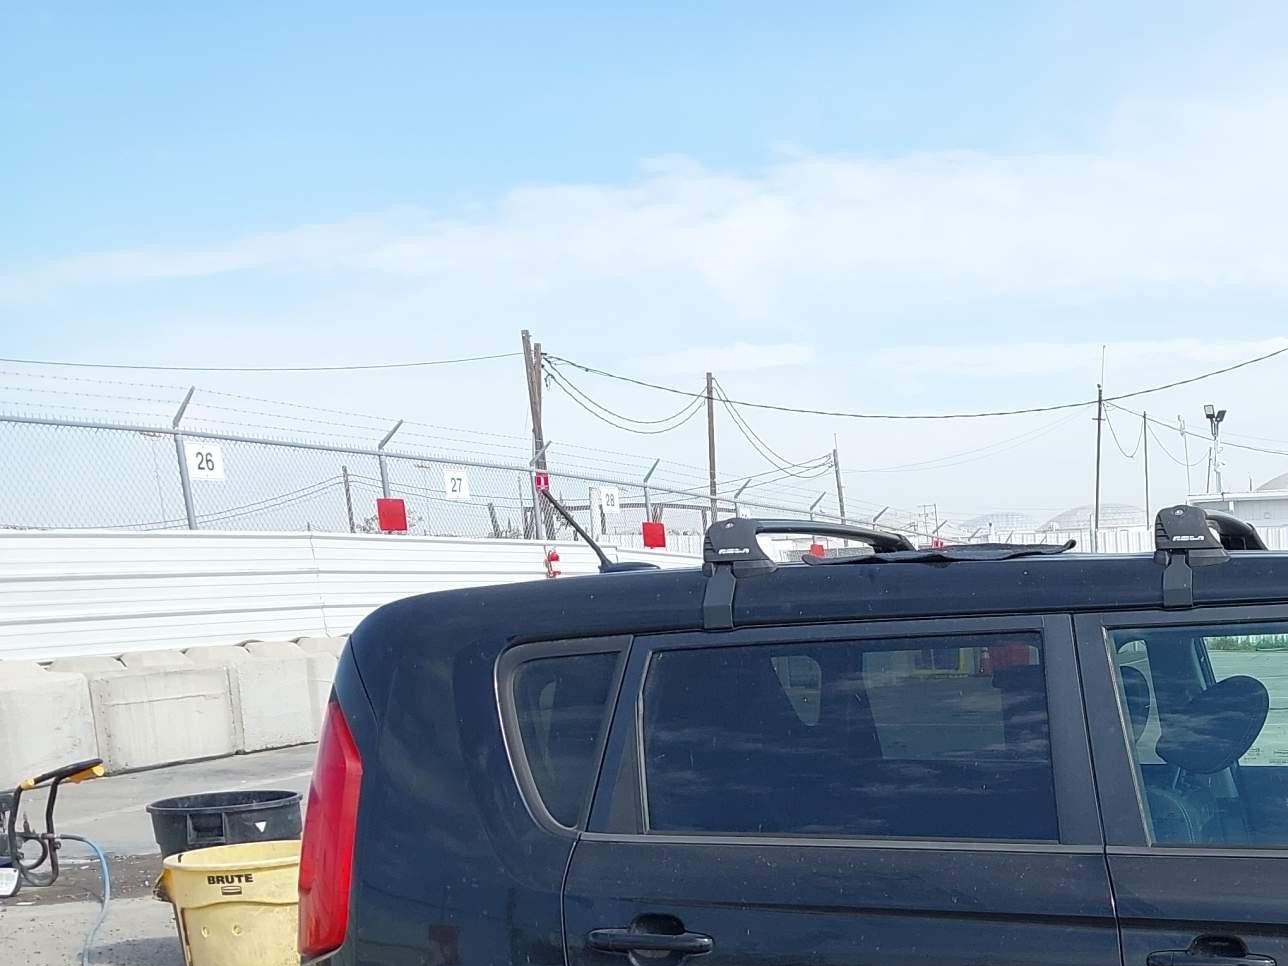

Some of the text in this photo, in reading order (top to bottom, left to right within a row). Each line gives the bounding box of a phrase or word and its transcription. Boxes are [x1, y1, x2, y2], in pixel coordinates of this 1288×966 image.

[195, 451, 215, 471] 26
[450, 477, 463, 493] 27
[605, 493, 616, 507] 28
[206, 873, 254, 885] BRUTE
